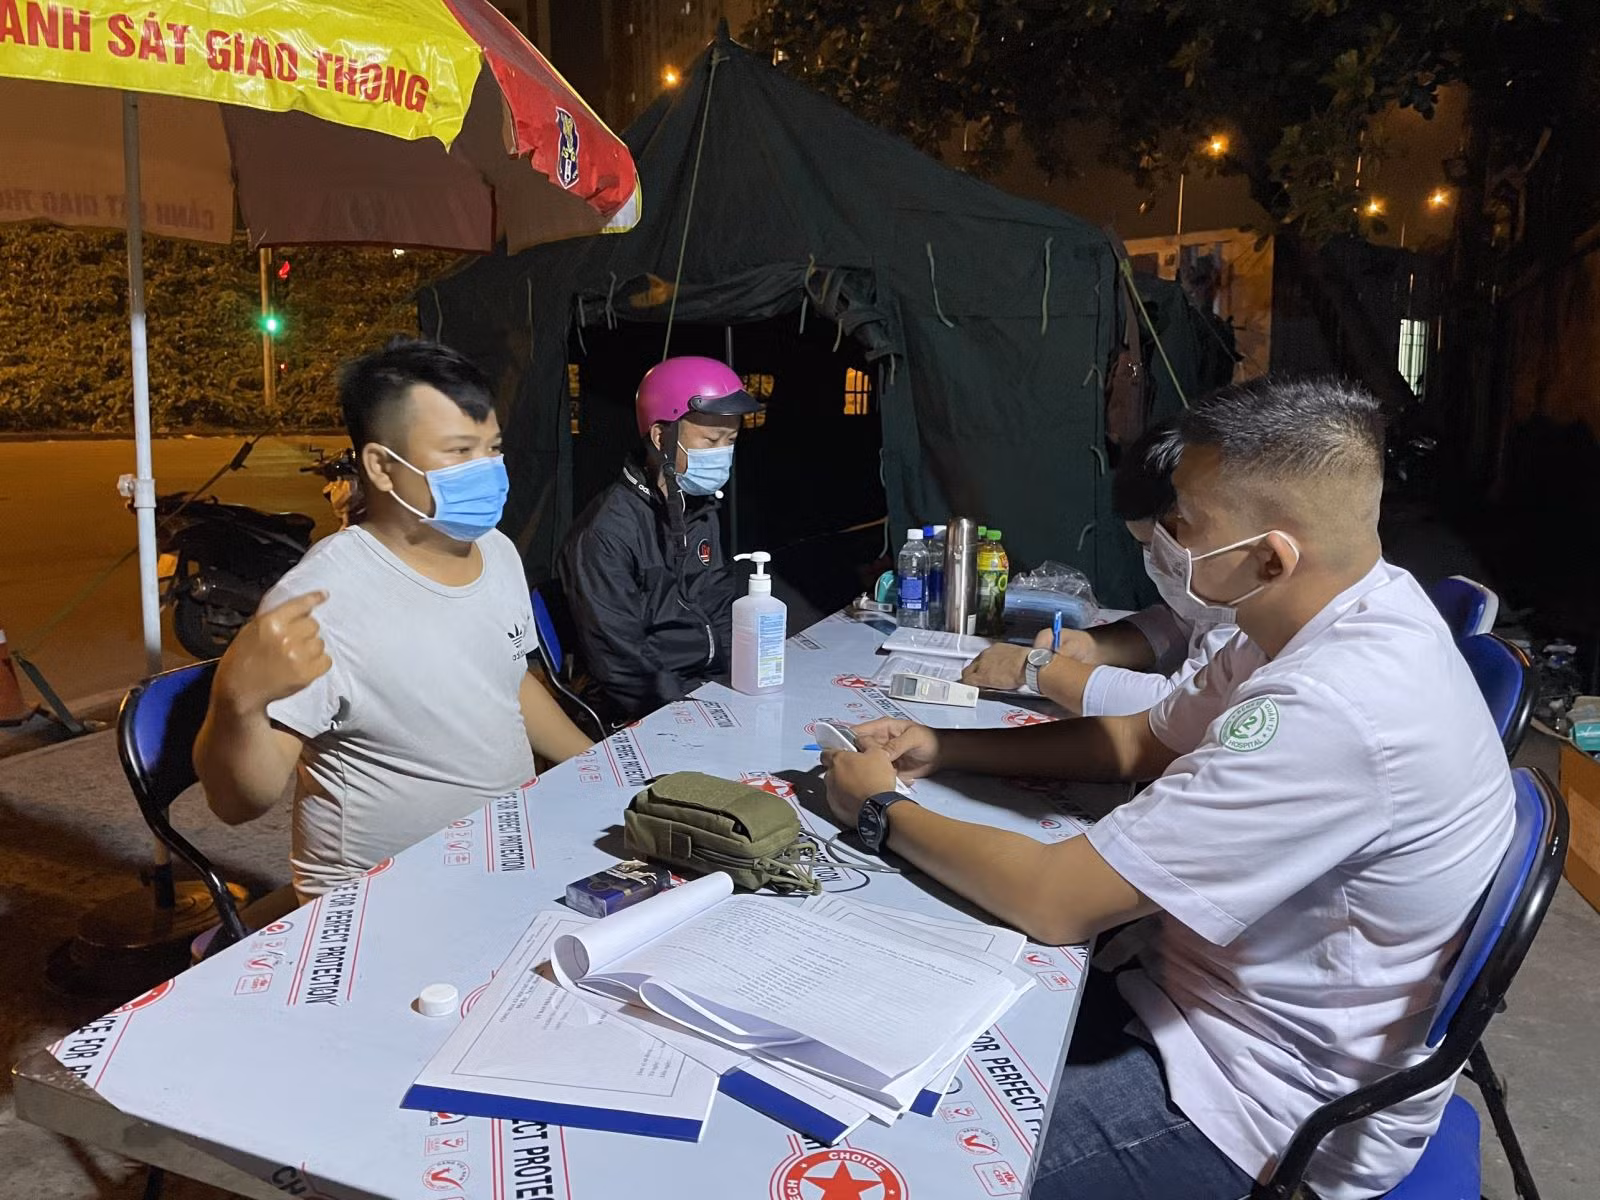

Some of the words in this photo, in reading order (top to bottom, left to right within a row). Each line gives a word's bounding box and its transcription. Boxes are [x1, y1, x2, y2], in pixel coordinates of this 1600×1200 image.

[107, 11, 189, 66] SÁT
[205, 29, 299, 82] GIAO
[1228, 739, 1264, 749] HOSPITAL
[496, 800, 519, 811] FOR
[497, 811, 521, 834] PERFECT
[499, 834, 526, 872] PROTECTION
[328, 893, 357, 908] FOR
[319, 909, 354, 944] PERFECT
[304, 945, 347, 1005] PROTECTION
[62, 1037, 107, 1061] FOR
[980, 1057, 1046, 1113] PERFECT
[513, 1145, 556, 1200] PROTE
[828, 1151, 886, 1175] CHOICE
